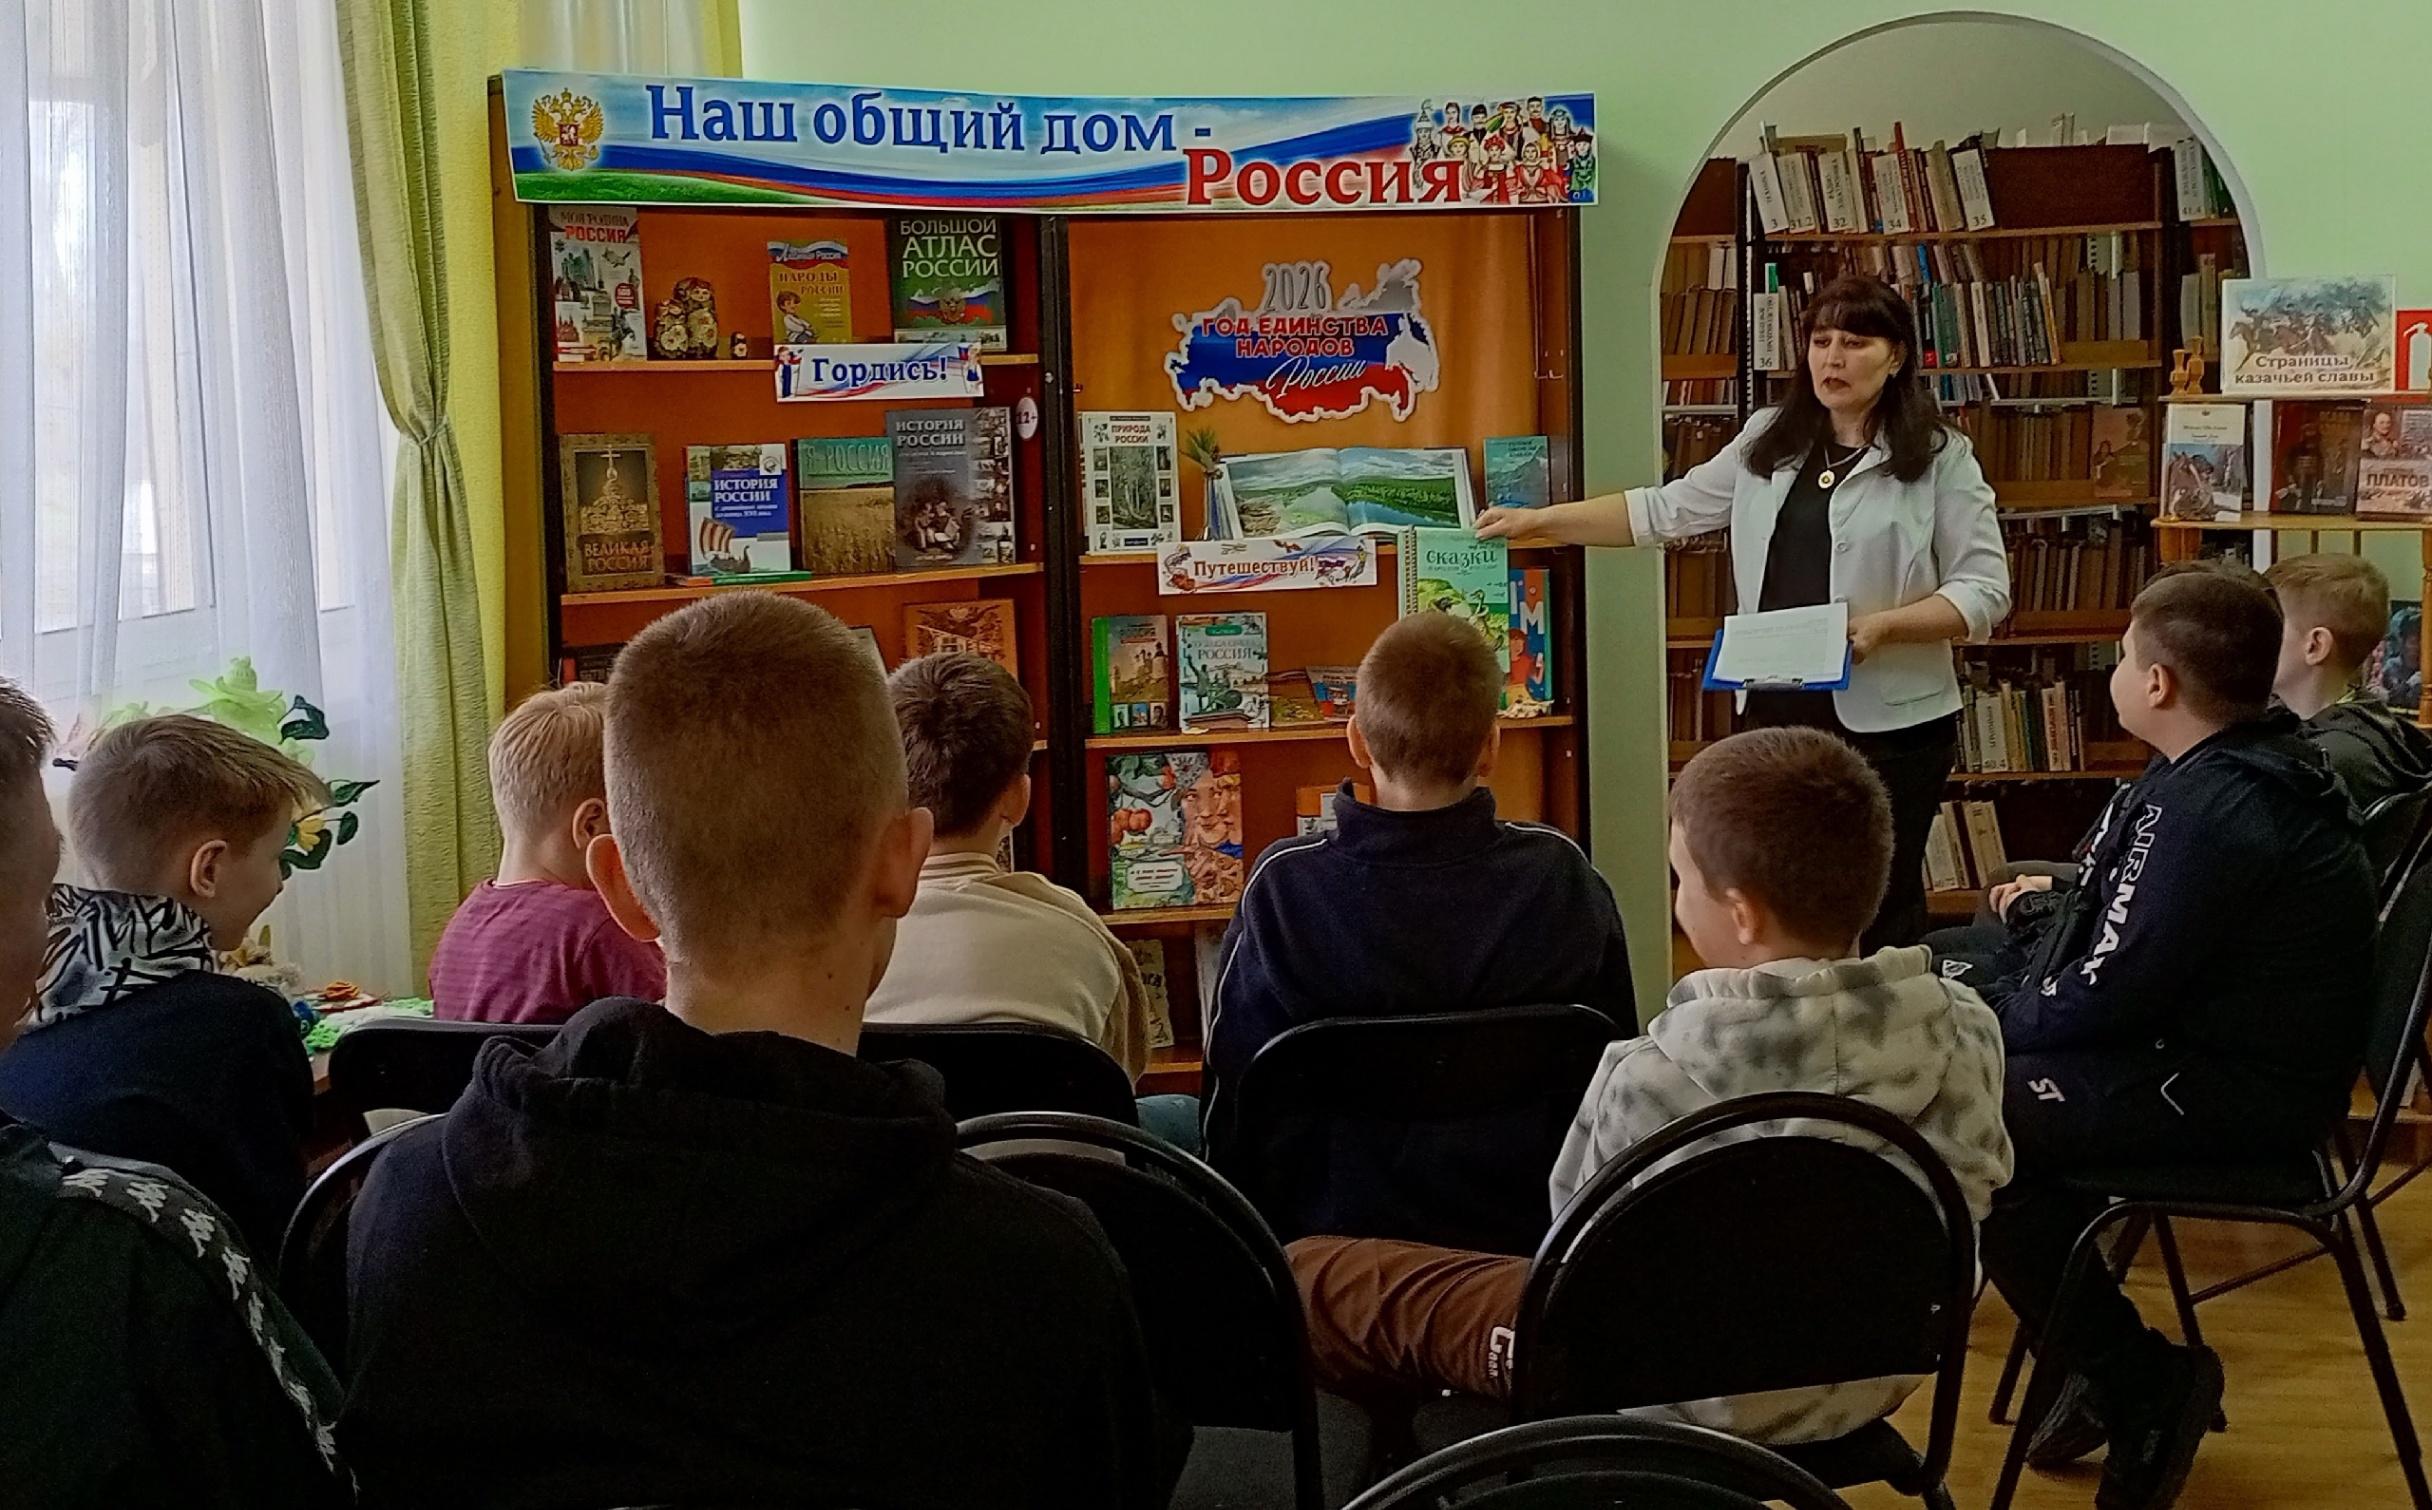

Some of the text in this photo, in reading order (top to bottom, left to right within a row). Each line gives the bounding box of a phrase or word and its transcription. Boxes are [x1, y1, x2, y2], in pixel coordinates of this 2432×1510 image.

[646, 84, 799, 143] Наш
[813, 92, 1026, 154] общий
[1041, 112, 1177, 155] дом
[1183, 148, 1465, 205] Россия
[565, 225, 627, 243] РОССИЯ
[899, 215, 998, 236] БОЛЬШОЙ
[902, 235, 999, 259] АТЛАС
[779, 271, 839, 282] НАРОДЫ
[902, 258, 999, 278] РОССИИ
[1264, 265, 1328, 311] 2026
[1201, 314, 1389, 338] ГОД ЕДИНСТВА
[1235, 337, 1355, 358] НАРОДОВ
[812, 356, 949, 385] Гордись!
[2255, 354, 2350, 370] Страницы
[1266, 356, 1367, 398] России
[2234, 369, 2375, 384] казачьей славы
[894, 419, 965, 433] ИСТОРИЯ
[1015, 411, 1037, 425] 12+
[1110, 424, 1152, 434] ПРИРОДА
[896, 433, 965, 448] РОССИИ
[1115, 435, 1150, 444] РОССИИ
[713, 479, 778, 491] ИСТОРИЯ
[2366, 473, 2430, 488] ПЛАТОВ
[714, 491, 771, 503] РОССИИ
[584, 541, 650, 557] ВЕЛИКАЯ
[587, 555, 649, 572] РОССИЯ
[1193, 556, 1315, 578] Путешествуй!
[2027, 1077, 2066, 1102] ST
